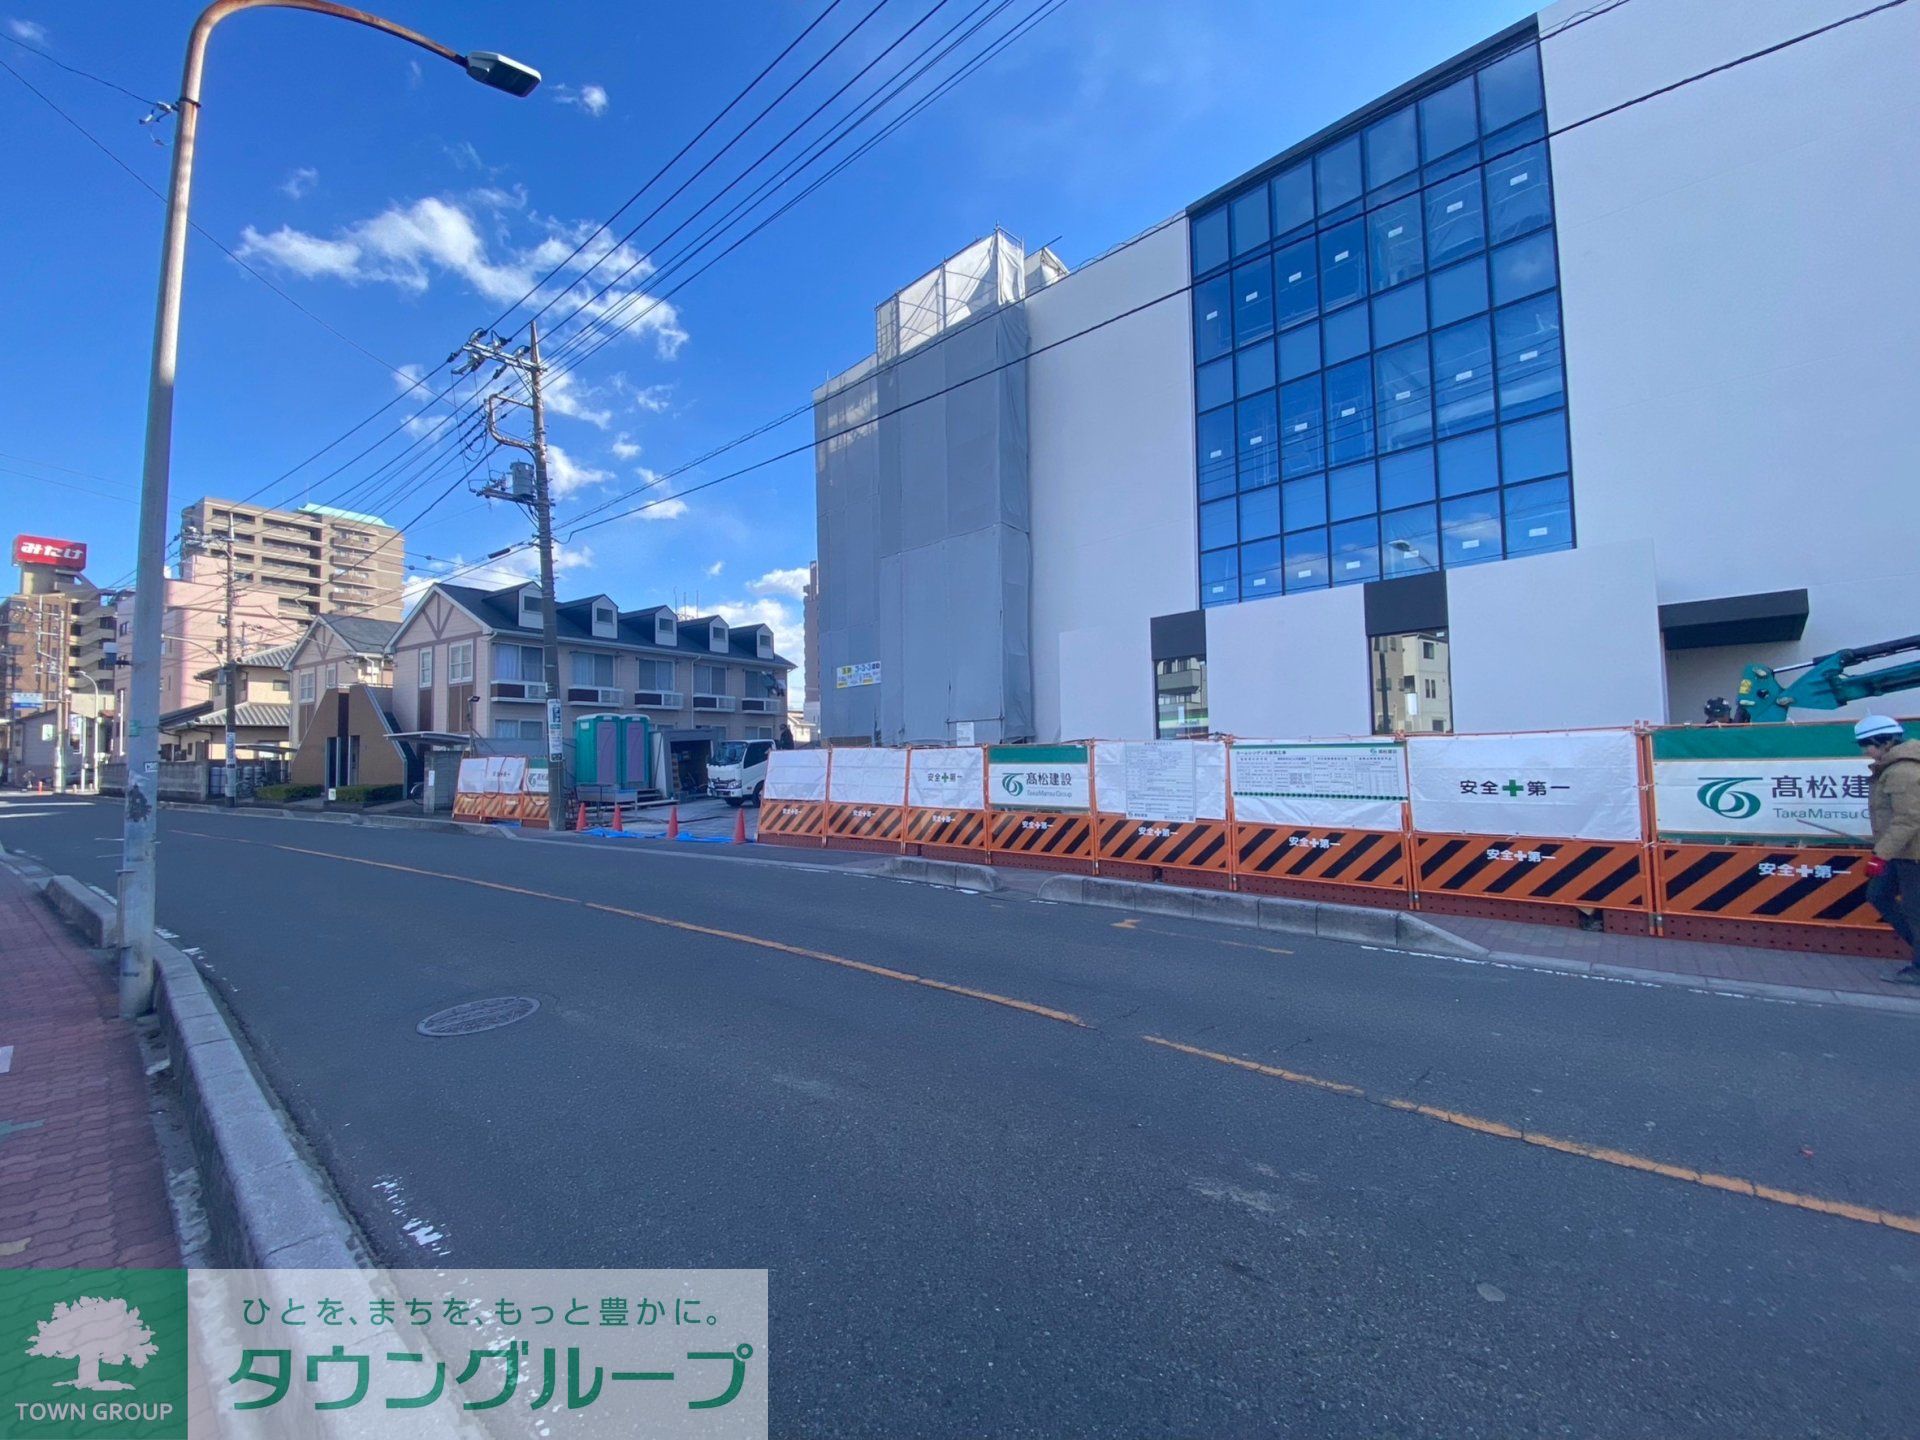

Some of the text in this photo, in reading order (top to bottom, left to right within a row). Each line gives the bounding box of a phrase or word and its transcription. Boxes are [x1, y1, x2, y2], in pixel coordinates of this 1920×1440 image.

[21, 541, 83, 560] みたけ
[1773, 808, 1858, 819] TakaMatsu
